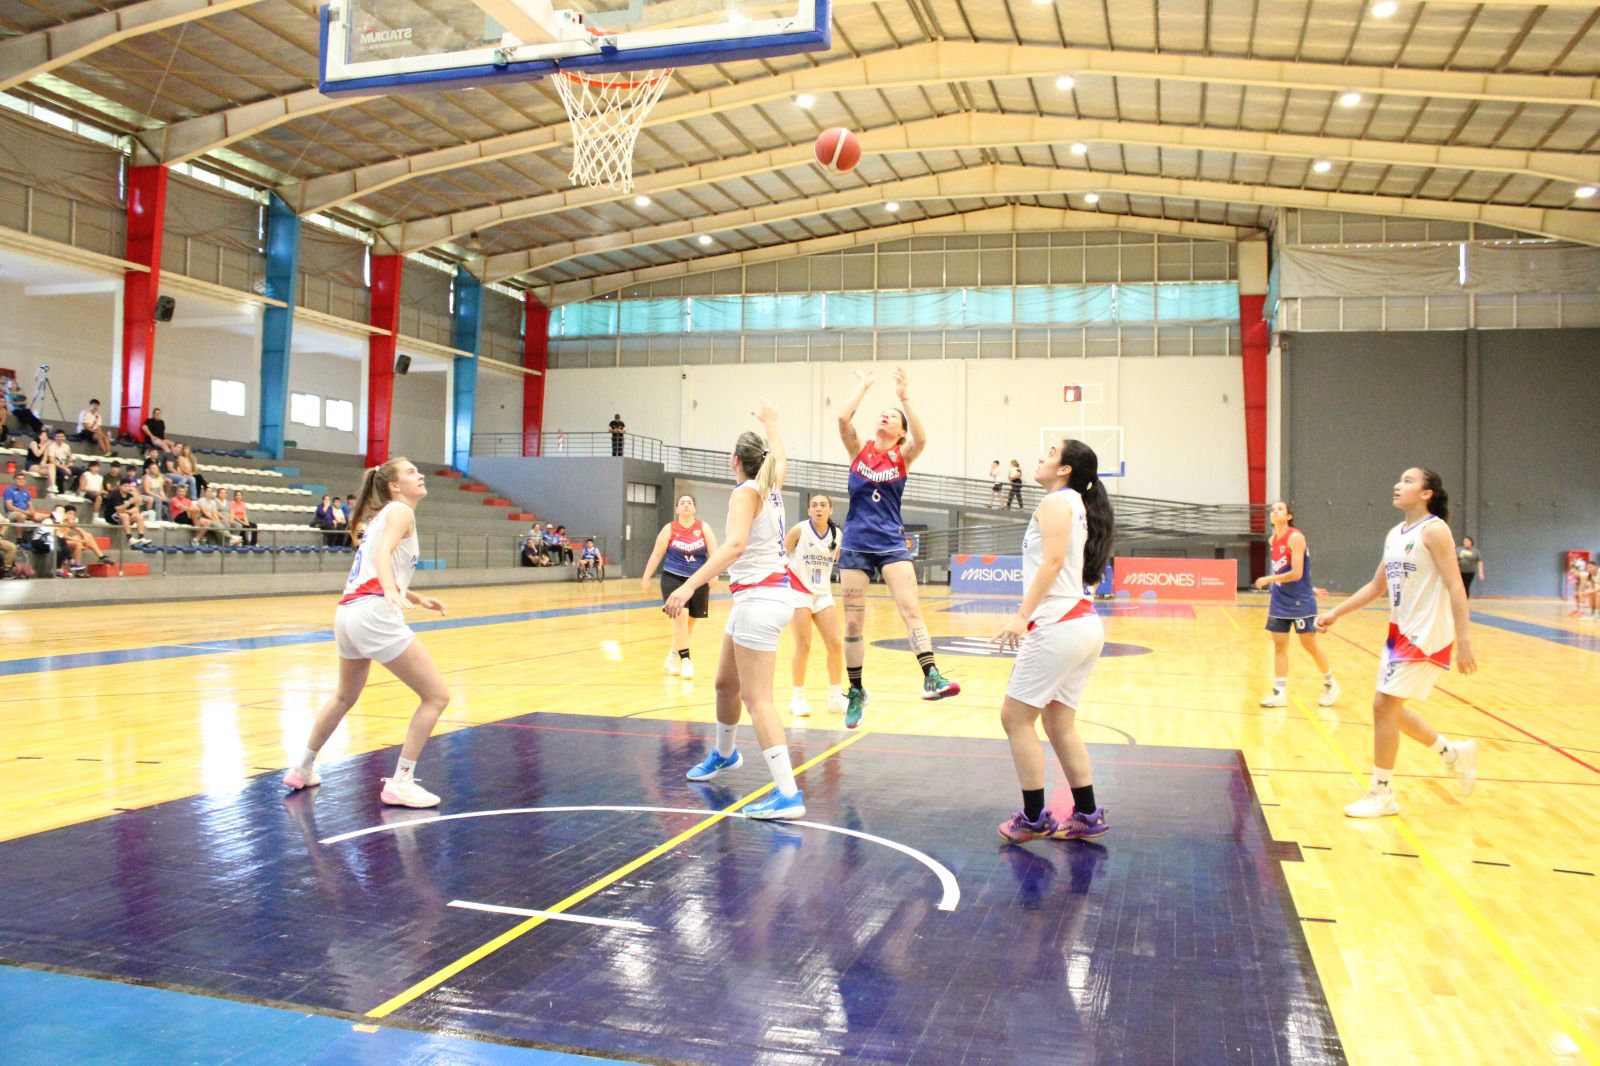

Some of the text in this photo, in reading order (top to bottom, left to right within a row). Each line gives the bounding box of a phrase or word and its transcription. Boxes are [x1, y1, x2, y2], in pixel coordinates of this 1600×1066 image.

[857, 460, 900, 483] MISIONES
[871, 489, 881, 502] 6
[1123, 572, 1195, 586] MISIONES
